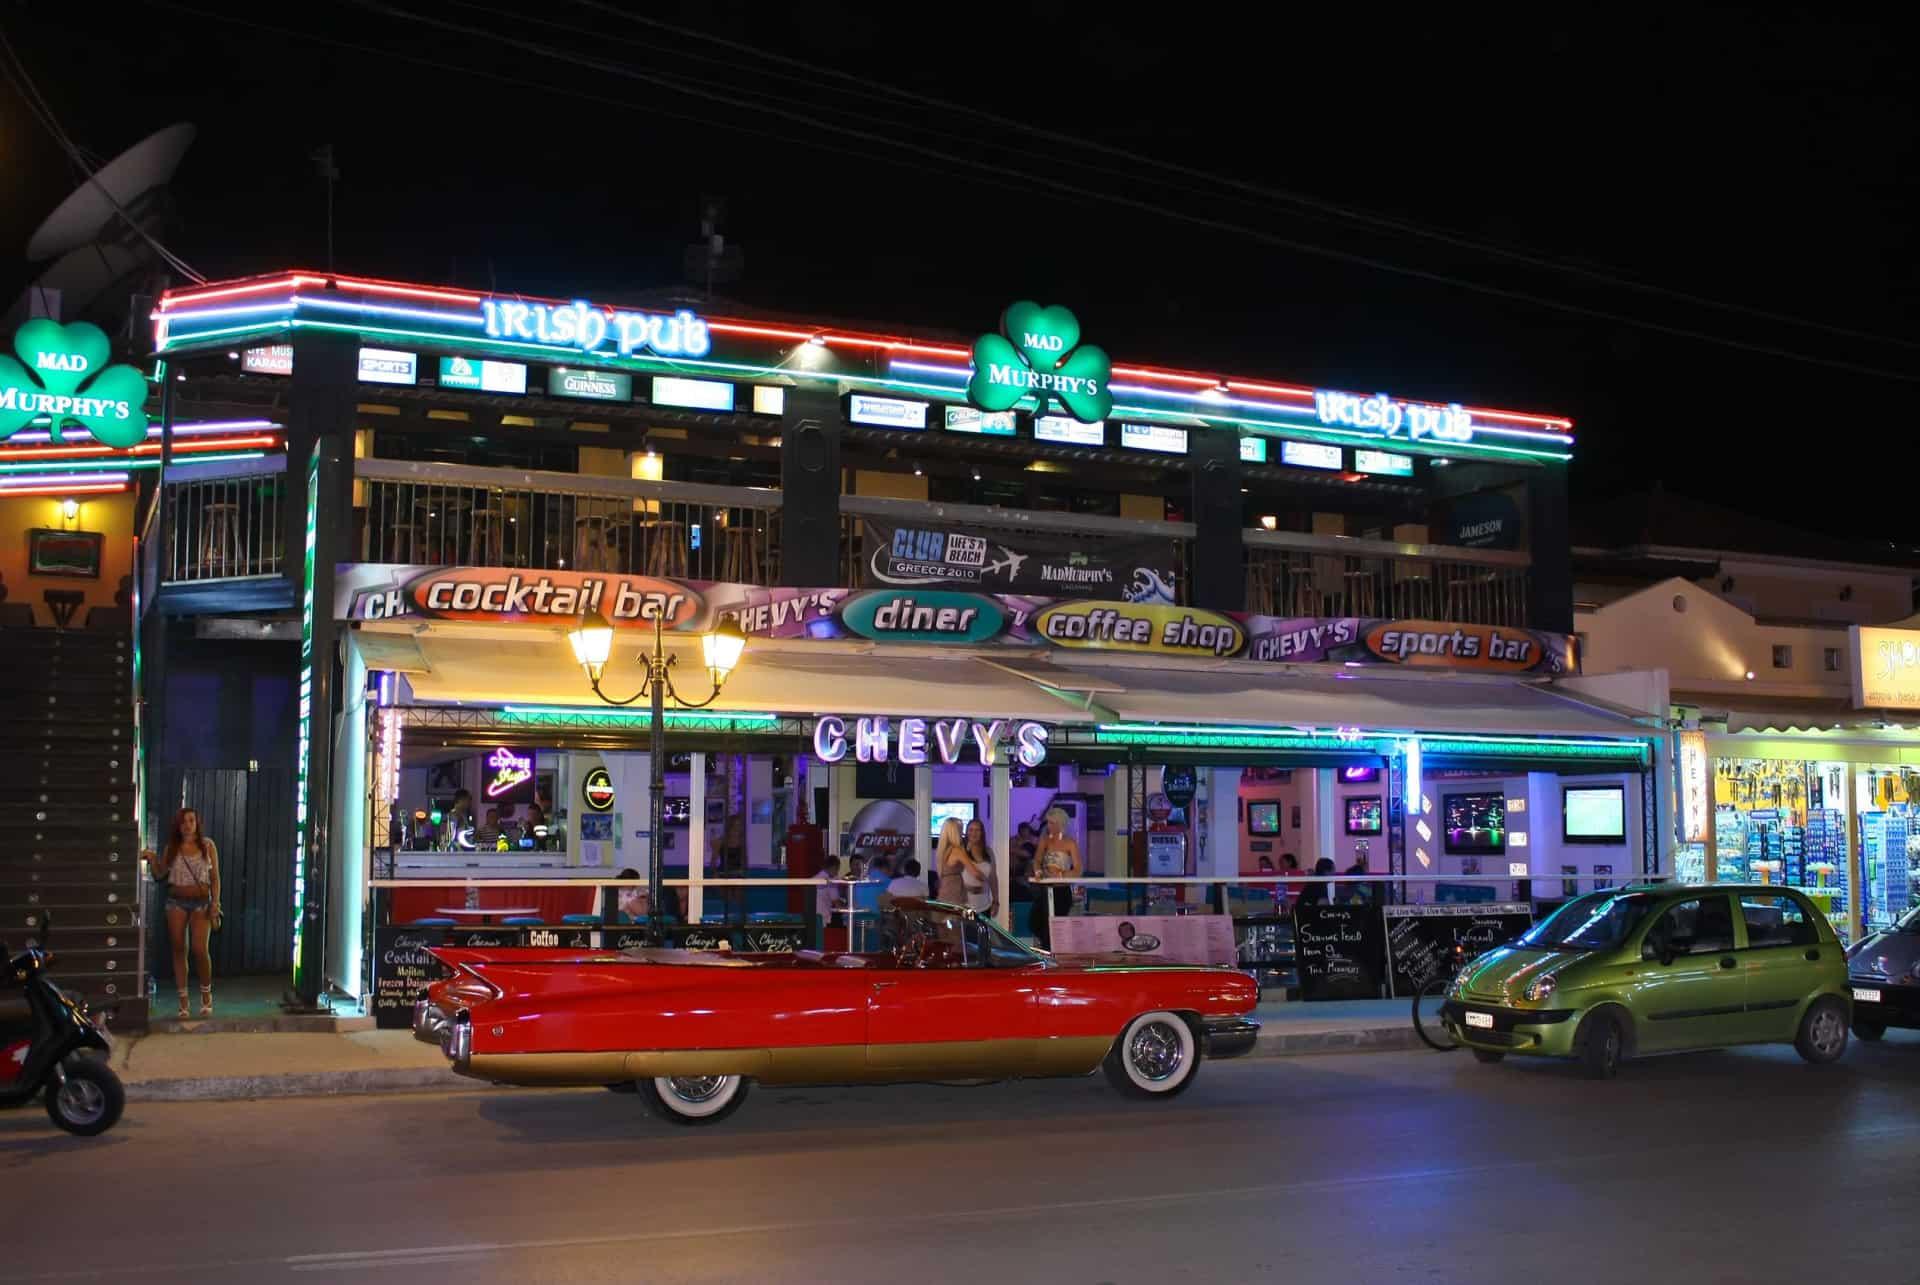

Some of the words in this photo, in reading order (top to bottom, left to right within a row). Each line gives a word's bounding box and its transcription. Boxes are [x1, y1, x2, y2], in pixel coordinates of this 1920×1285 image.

[1023, 332, 1063, 352] MAD
[37, 351, 88, 372] MAD
[362, 360, 409, 374] SPORTS
[564, 377, 616, 395] GUINNESS
[989, 364, 1098, 396] MURPHY'S
[0, 387, 130, 419] MURPHY'S
[1459, 519, 1503, 538] JAMESON
[892, 528, 945, 561] CLUB
[950, 536, 976, 549] LIFE'S
[949, 549, 981, 564] BEACH
[896, 562, 946, 577] GREECE
[946, 568, 975, 579] 2010
[364, 590, 413, 620] CH
[427, 576, 603, 613] cocktail
[613, 582, 685, 621] bar
[873, 598, 978, 632] diner
[1049, 609, 1150, 643] coffee
[1163, 615, 1234, 651] shop
[1259, 621, 1350, 660] CHEVY'S
[1380, 629, 1479, 660] sports
[1488, 631, 1531, 661] bar
[489, 755, 531, 769] COFFEE
[1151, 836, 1180, 846] DIESEL
[530, 931, 559, 947] Coffee
